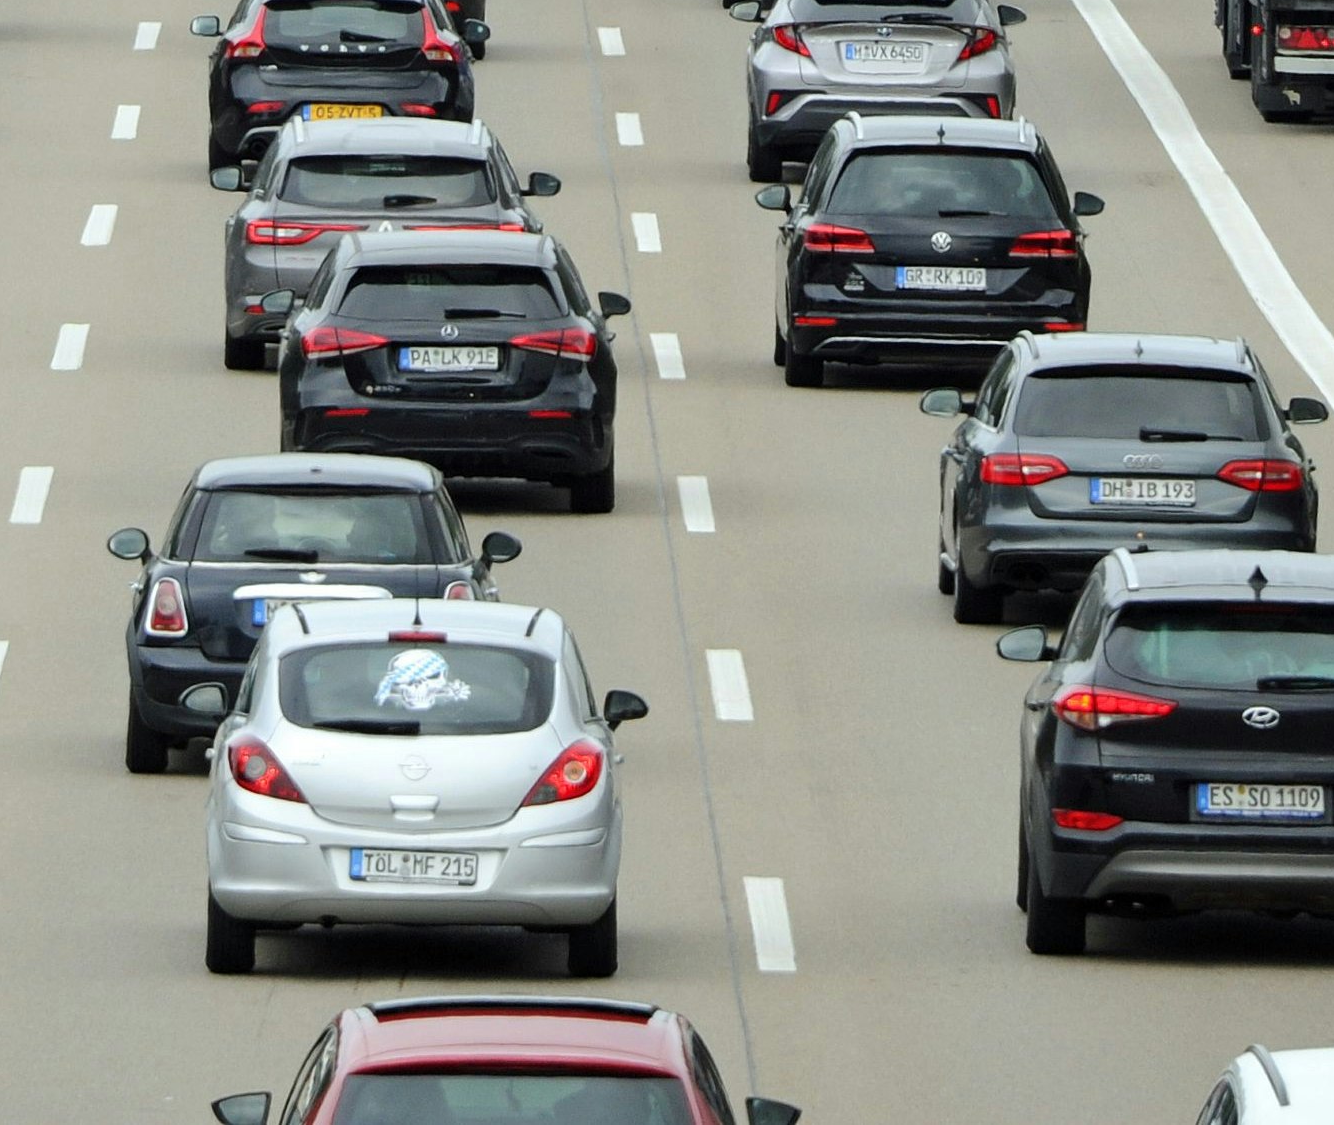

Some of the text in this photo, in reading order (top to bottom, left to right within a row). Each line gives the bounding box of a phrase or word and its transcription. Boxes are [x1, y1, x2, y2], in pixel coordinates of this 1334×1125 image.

[890, 46, 922, 60] 6450
[905, 269, 983, 285] GR RK 109
[410, 348, 431, 365] PA
[441, 349, 461, 366] LK
[1101, 483, 1193, 500] DH IB 193
[1209, 786, 1232, 806] ES
[1278, 787, 1320, 809] 1109
[364, 853, 475, 877] TÖL MF 215
